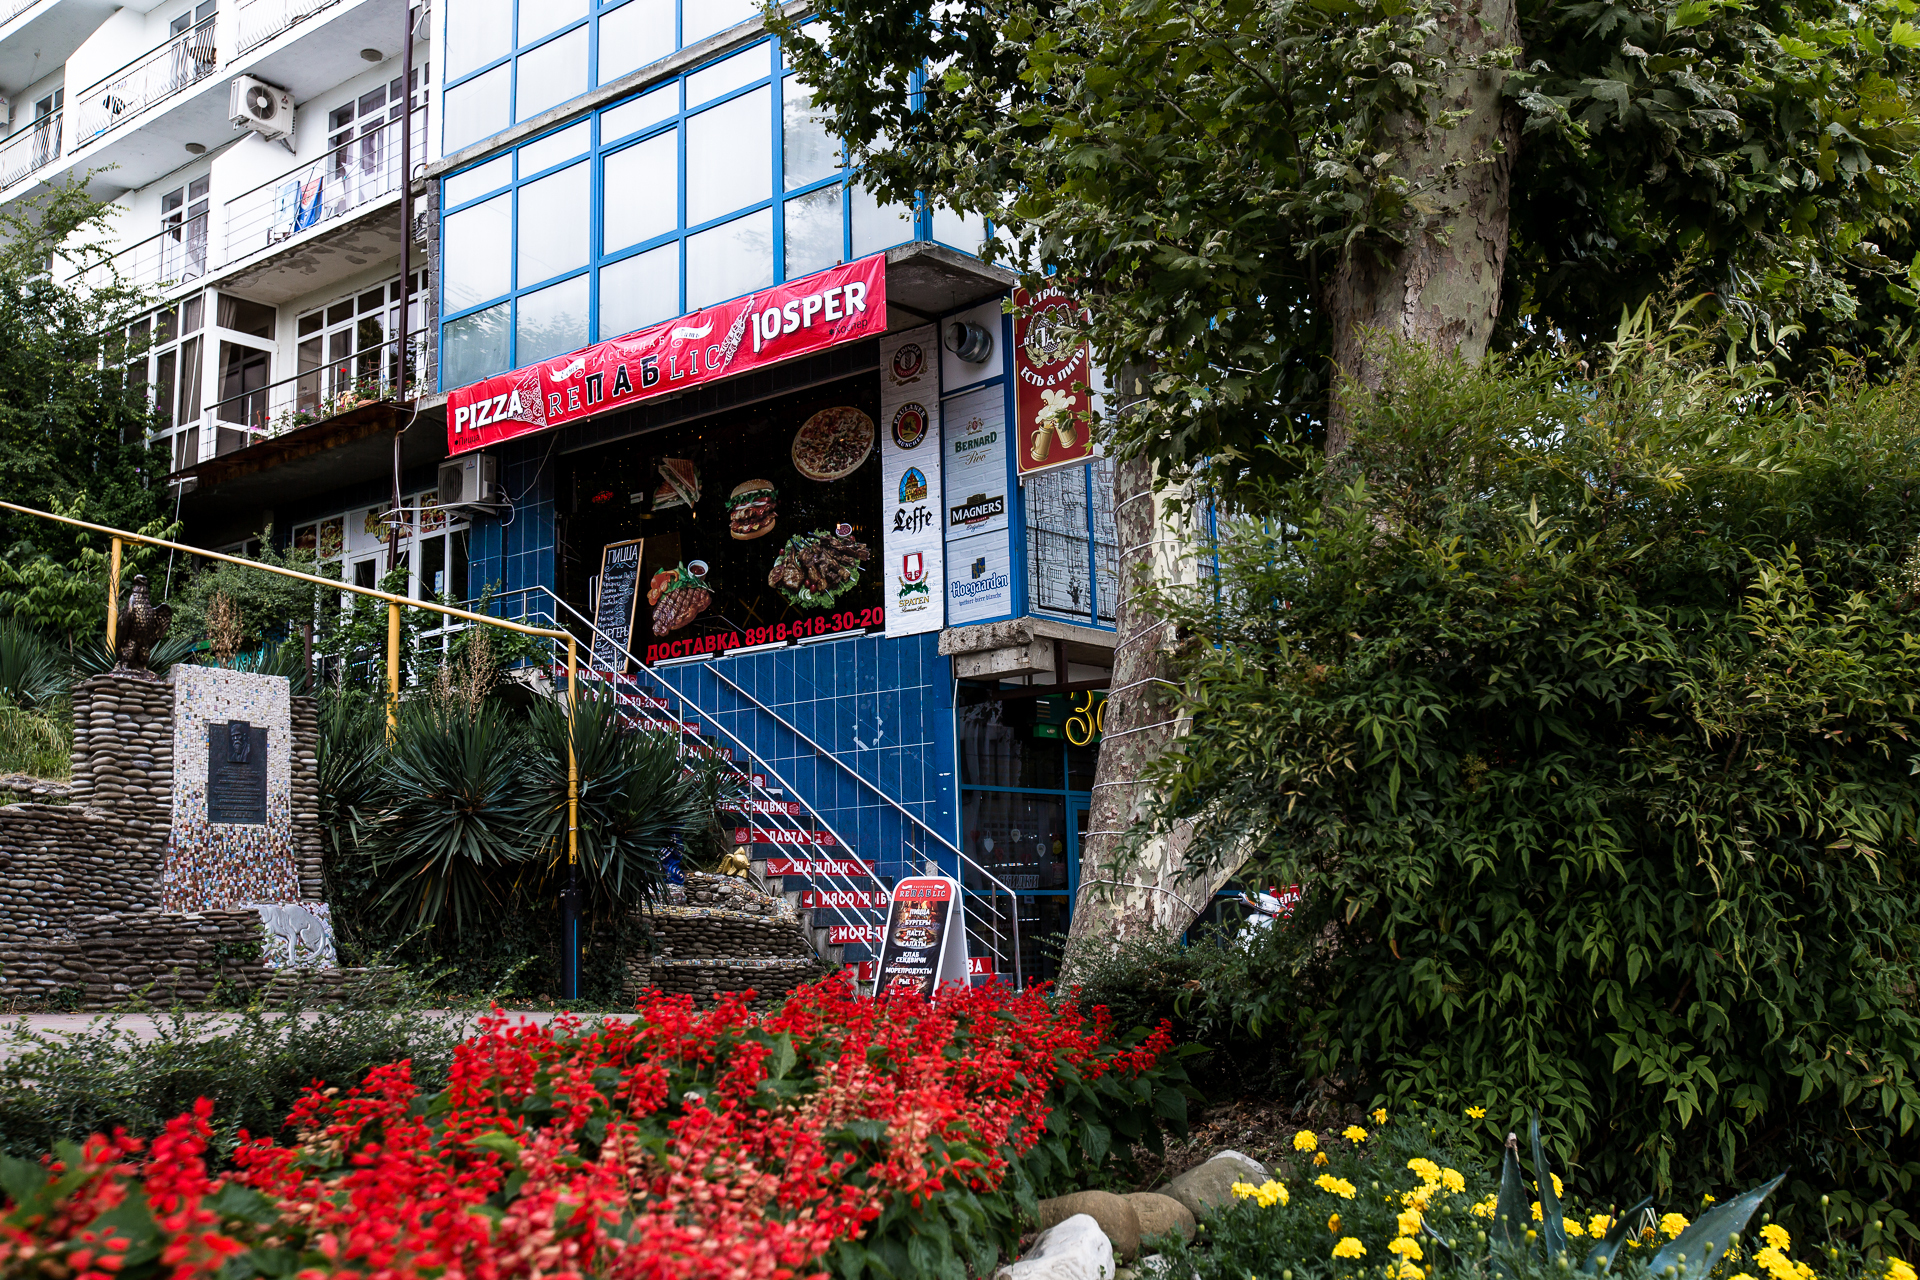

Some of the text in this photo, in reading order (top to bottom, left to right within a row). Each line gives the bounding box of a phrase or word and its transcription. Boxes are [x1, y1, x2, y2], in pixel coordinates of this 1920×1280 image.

[751, 281, 867, 353] JOSPER
[592, 335, 665, 367] ГАСТРОПАБ
[1020, 348, 1085, 387] ЕСТЬ & ПИТЬ
[455, 389, 523, 434] PIZZA
[893, 404, 926, 424] PAULANER
[955, 431, 998, 453] BERNARD
[891, 505, 933, 535] Leffe
[952, 500, 1002, 523] MAGNERS
[951, 572, 1009, 599] Hoegaarden
[899, 596, 930, 608] SPATEN
[645, 631, 740, 665] ДОСТАВКА
[745, 606, 884, 646] 8918-618-30-20
[769, 830, 804, 843] ПАСТА
[793, 861, 849, 874] ШАШЛЫК
[822, 892, 854, 905] МЯСО
[906, 929, 926, 937] ПАСТА
[885, 967, 933, 975] МОРЕПРОДУКТЫ
